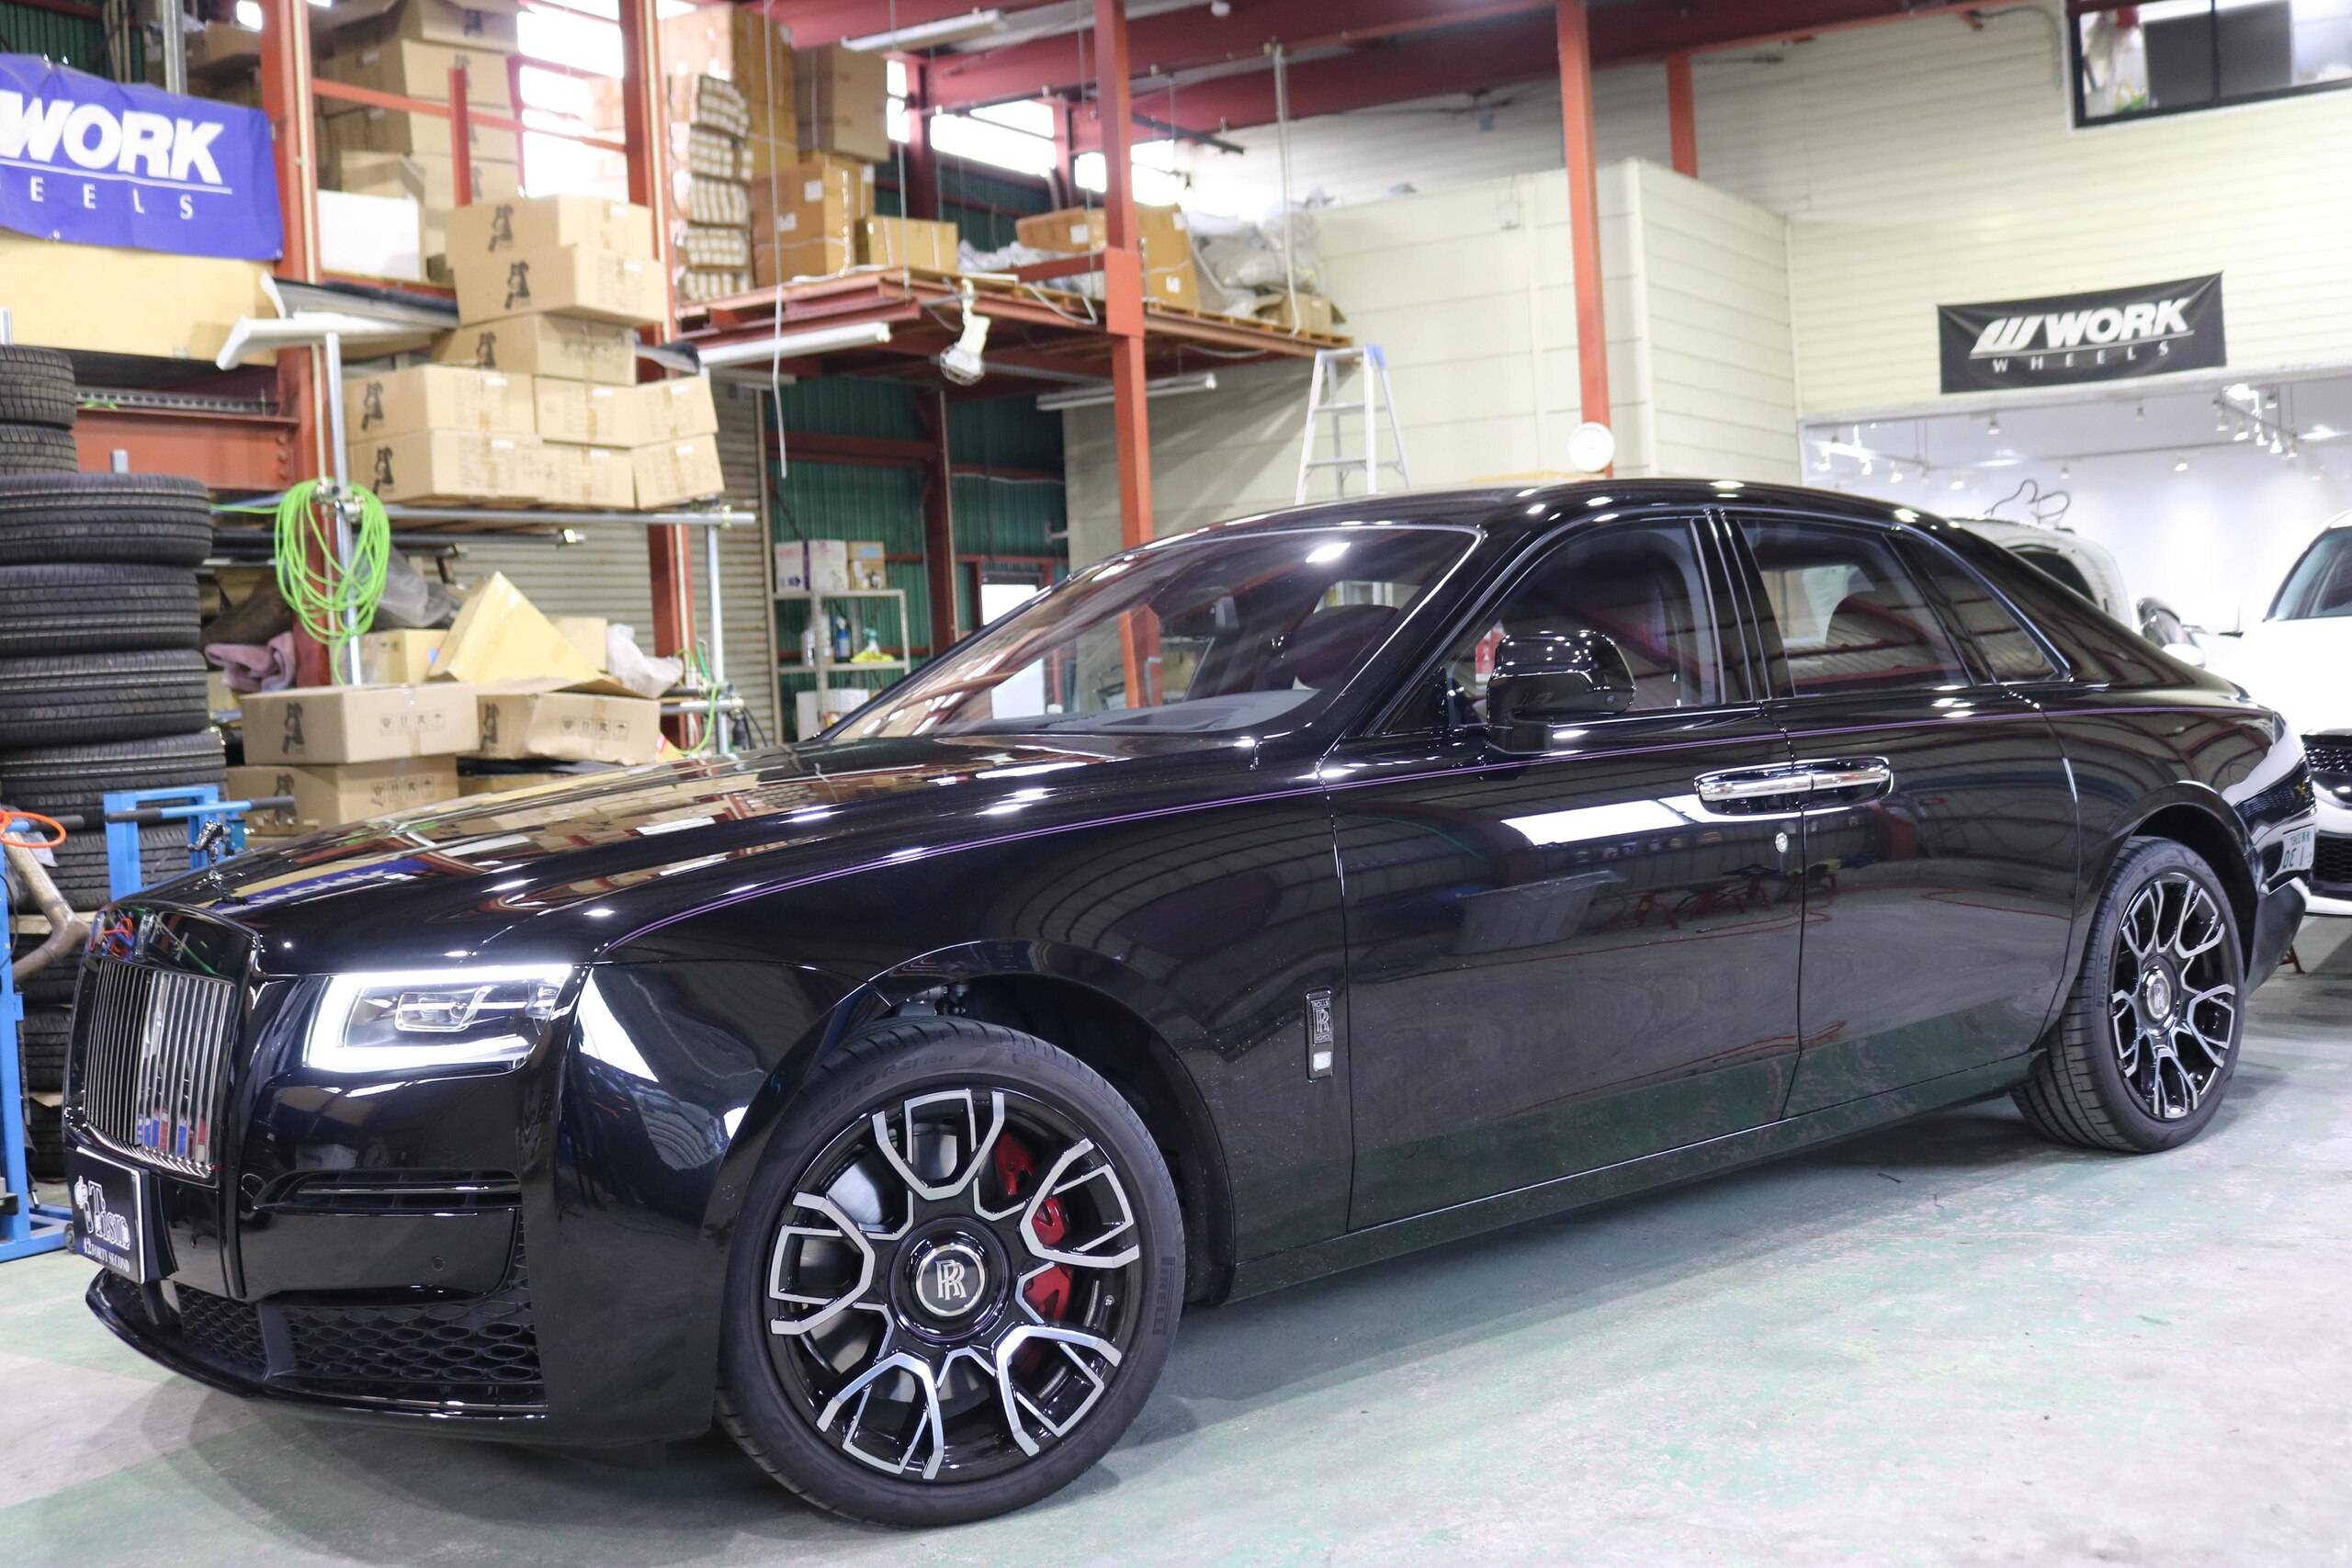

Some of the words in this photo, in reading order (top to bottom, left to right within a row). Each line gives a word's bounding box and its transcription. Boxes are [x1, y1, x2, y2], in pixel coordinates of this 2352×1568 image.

[0, 89, 224, 186] WORK
[2043, 297, 2192, 350] WORK
[1993, 341, 2168, 373] WHEELS
[108, 1250, 130, 1273] SECOND
[935, 1258, 967, 1302] RR
[1152, 1256, 1176, 1336] PIRELLI
